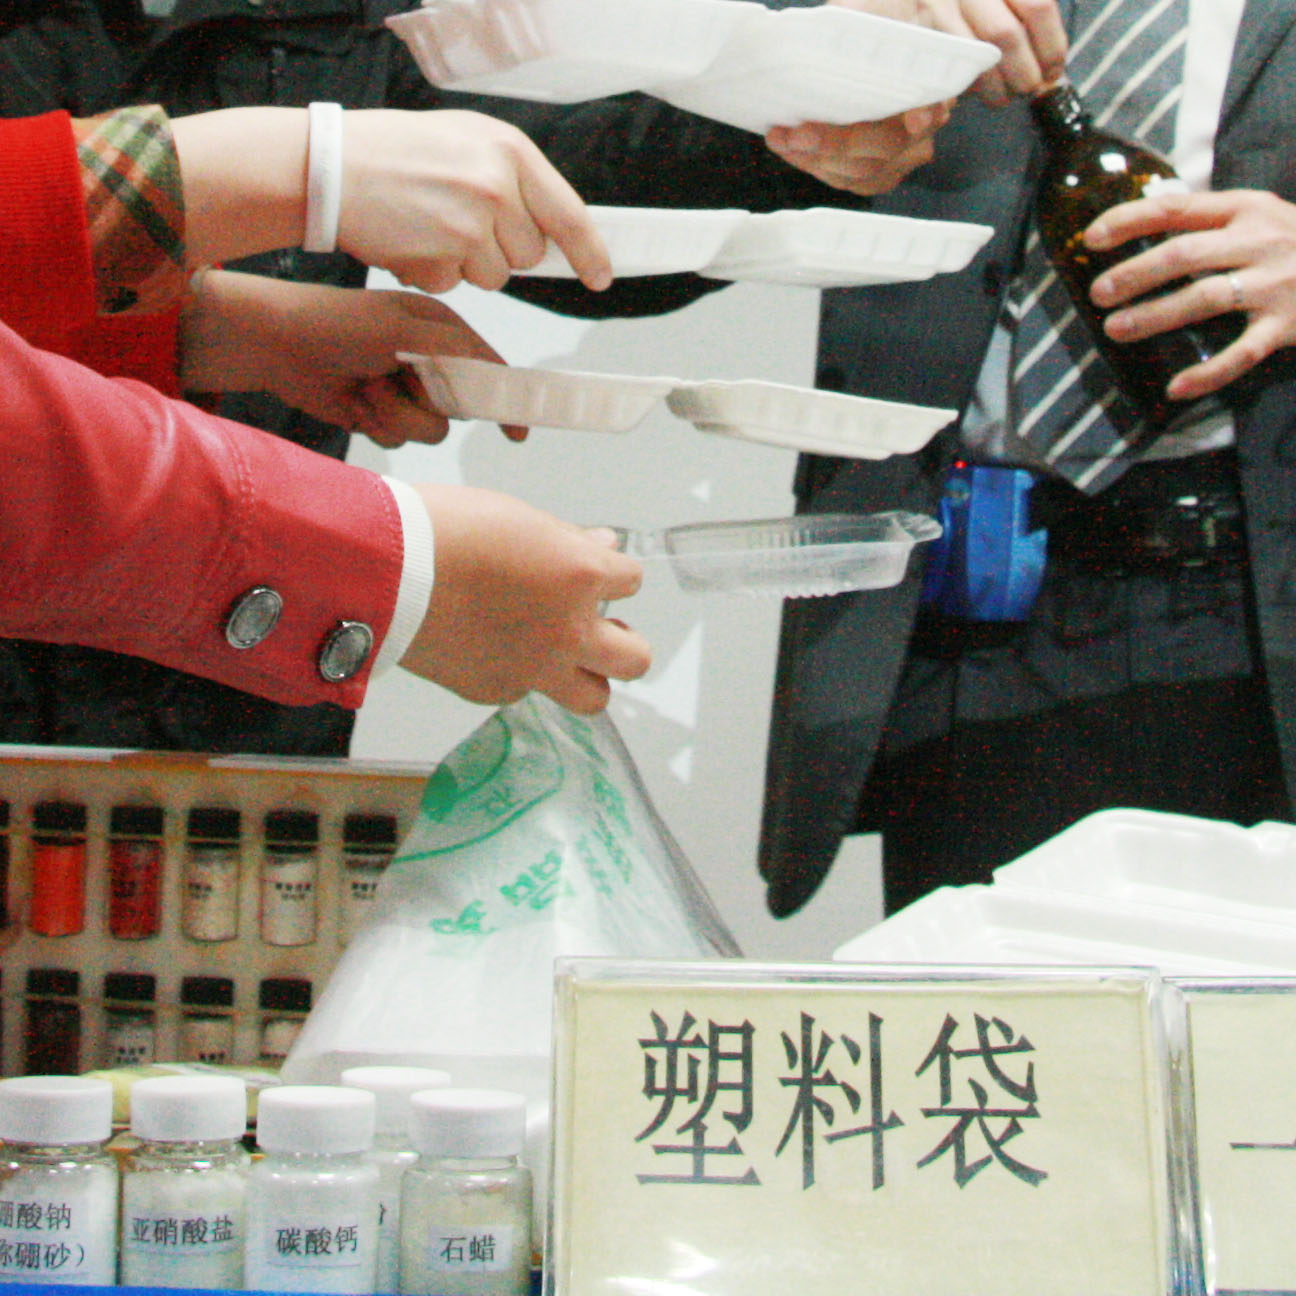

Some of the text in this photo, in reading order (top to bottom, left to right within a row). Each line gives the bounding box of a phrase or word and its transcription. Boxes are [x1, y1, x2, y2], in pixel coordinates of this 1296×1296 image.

[633, 1008, 1049, 1191] 塑料袋
[131, 1215, 235, 1247] 亚硝酸盐
[275, 1224, 360, 1257] 碳酸钙
[439, 1234, 498, 1264] 石蜡
